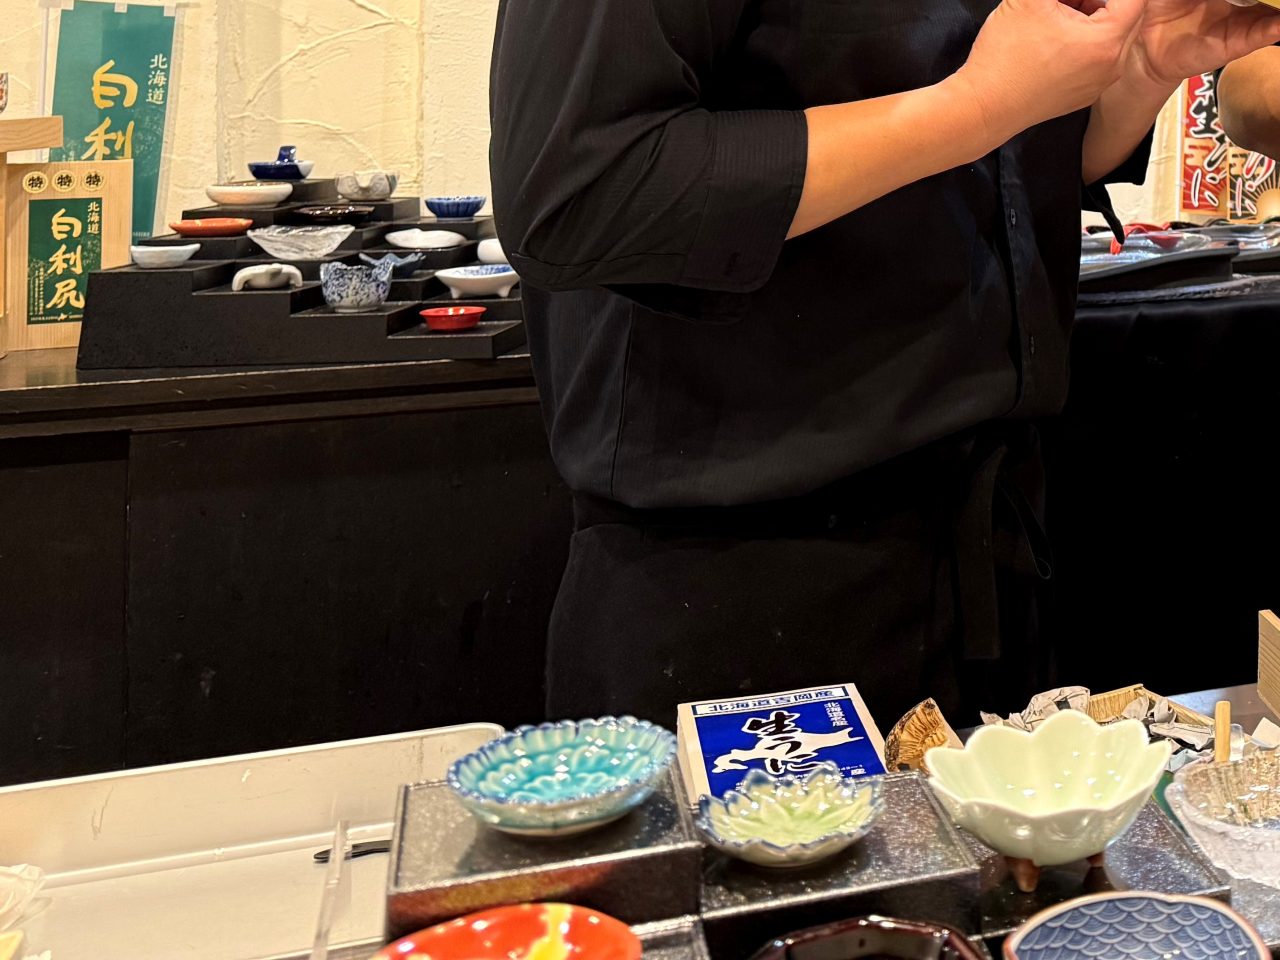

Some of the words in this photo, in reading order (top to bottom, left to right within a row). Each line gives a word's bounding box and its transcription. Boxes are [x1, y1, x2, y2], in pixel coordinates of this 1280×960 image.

[146, 53, 168, 105] 北海道
[87, 201, 100, 235] 北海道
[46, 208, 86, 309] 白利尻
